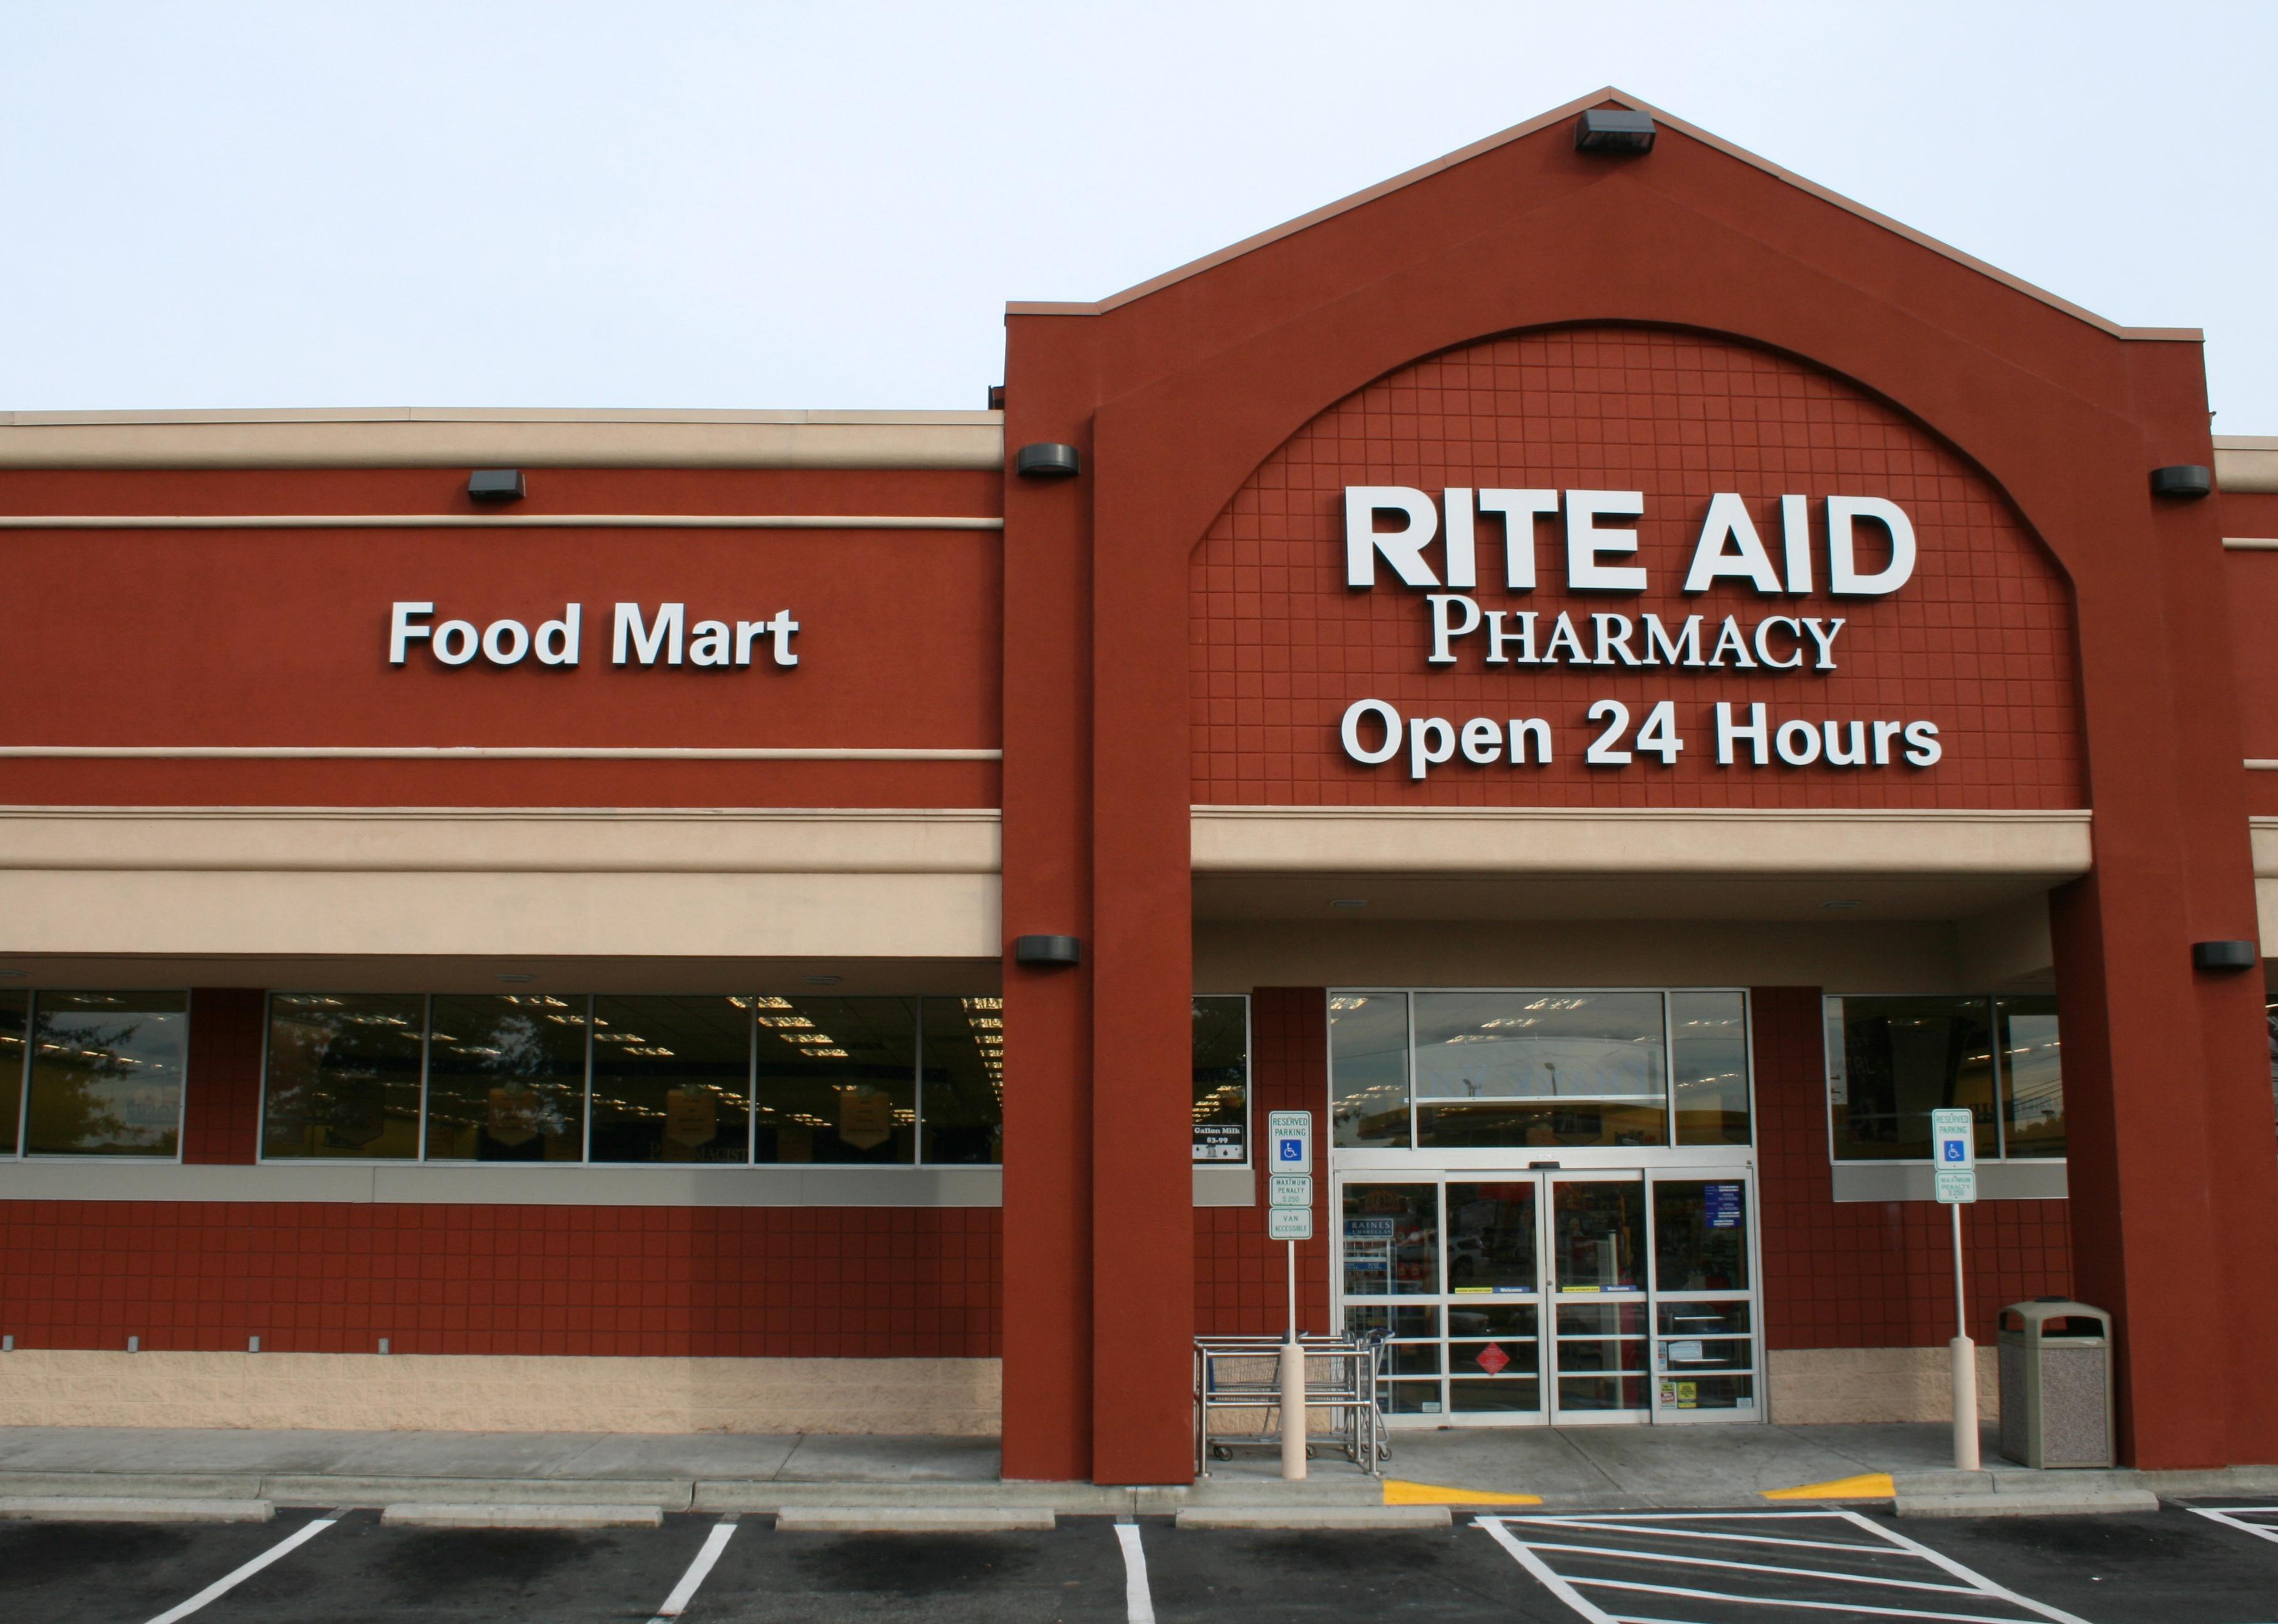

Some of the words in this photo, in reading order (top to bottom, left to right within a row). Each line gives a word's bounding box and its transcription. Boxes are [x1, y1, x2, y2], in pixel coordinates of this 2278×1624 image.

[1343, 486, 1648, 591] RITE
[1683, 492, 1917, 596] AID
[388, 601, 582, 666] Food
[611, 601, 800, 667] Mart
[1425, 594, 1847, 671] PHARMACY
[1340, 698, 1555, 781] Open
[1584, 699, 1685, 766] 24
[1715, 701, 1943, 769] Hours
[1272, 1117, 1308, 1126] RESERVED
[1274, 1128, 1306, 1137] PARKING
[1935, 1115, 1969, 1123] RESERVED
[1938, 1125, 1967, 1133] PARKING
